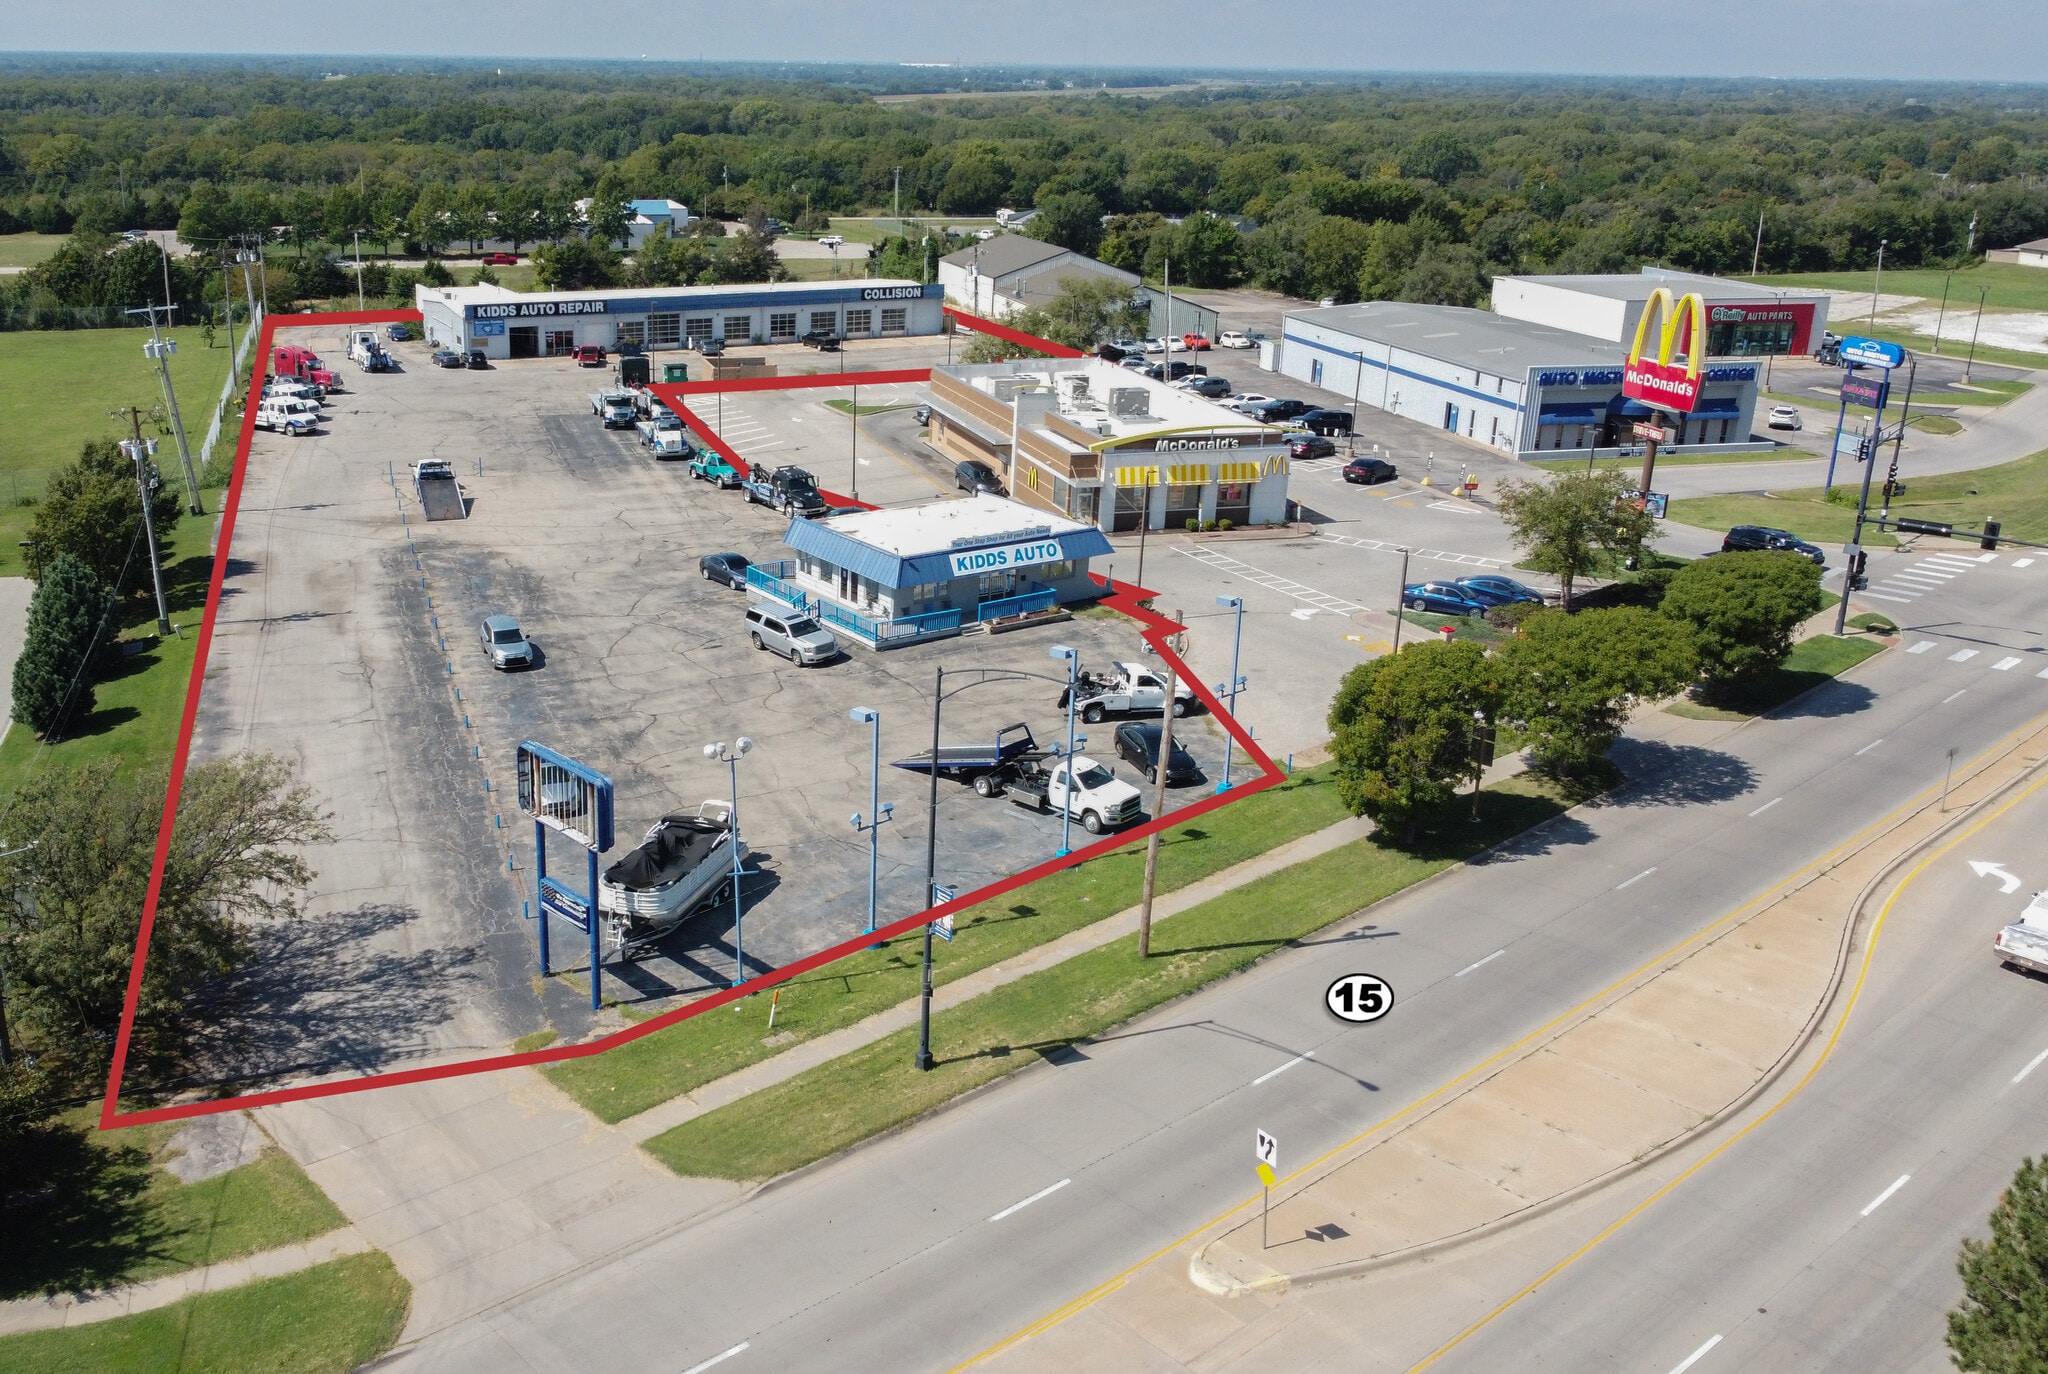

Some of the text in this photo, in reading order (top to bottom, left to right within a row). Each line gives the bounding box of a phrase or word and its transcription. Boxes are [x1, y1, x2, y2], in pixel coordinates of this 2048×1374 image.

[864, 287, 921, 299] COLLISION
[477, 301, 605, 318] KIDDS AUTO REPAIR
[1711, 306, 1793, 321] O'Reilly AUTO PARTS
[1845, 347, 1891, 362] AUTO MASTERS
[1539, 367, 1756, 386] AUTO MAST CENTER
[1626, 370, 1694, 396] McDonald's
[1633, 424, 1663, 440] DRIVE-THRU
[1155, 437, 1239, 452] McDonald's
[975, 537, 986, 545] Stop
[986, 535, 998, 544] Shop
[1025, 529, 1036, 537] Auto
[1036, 527, 1050, 535] Needs
[956, 542, 1057, 572] KIDDS AUTO
